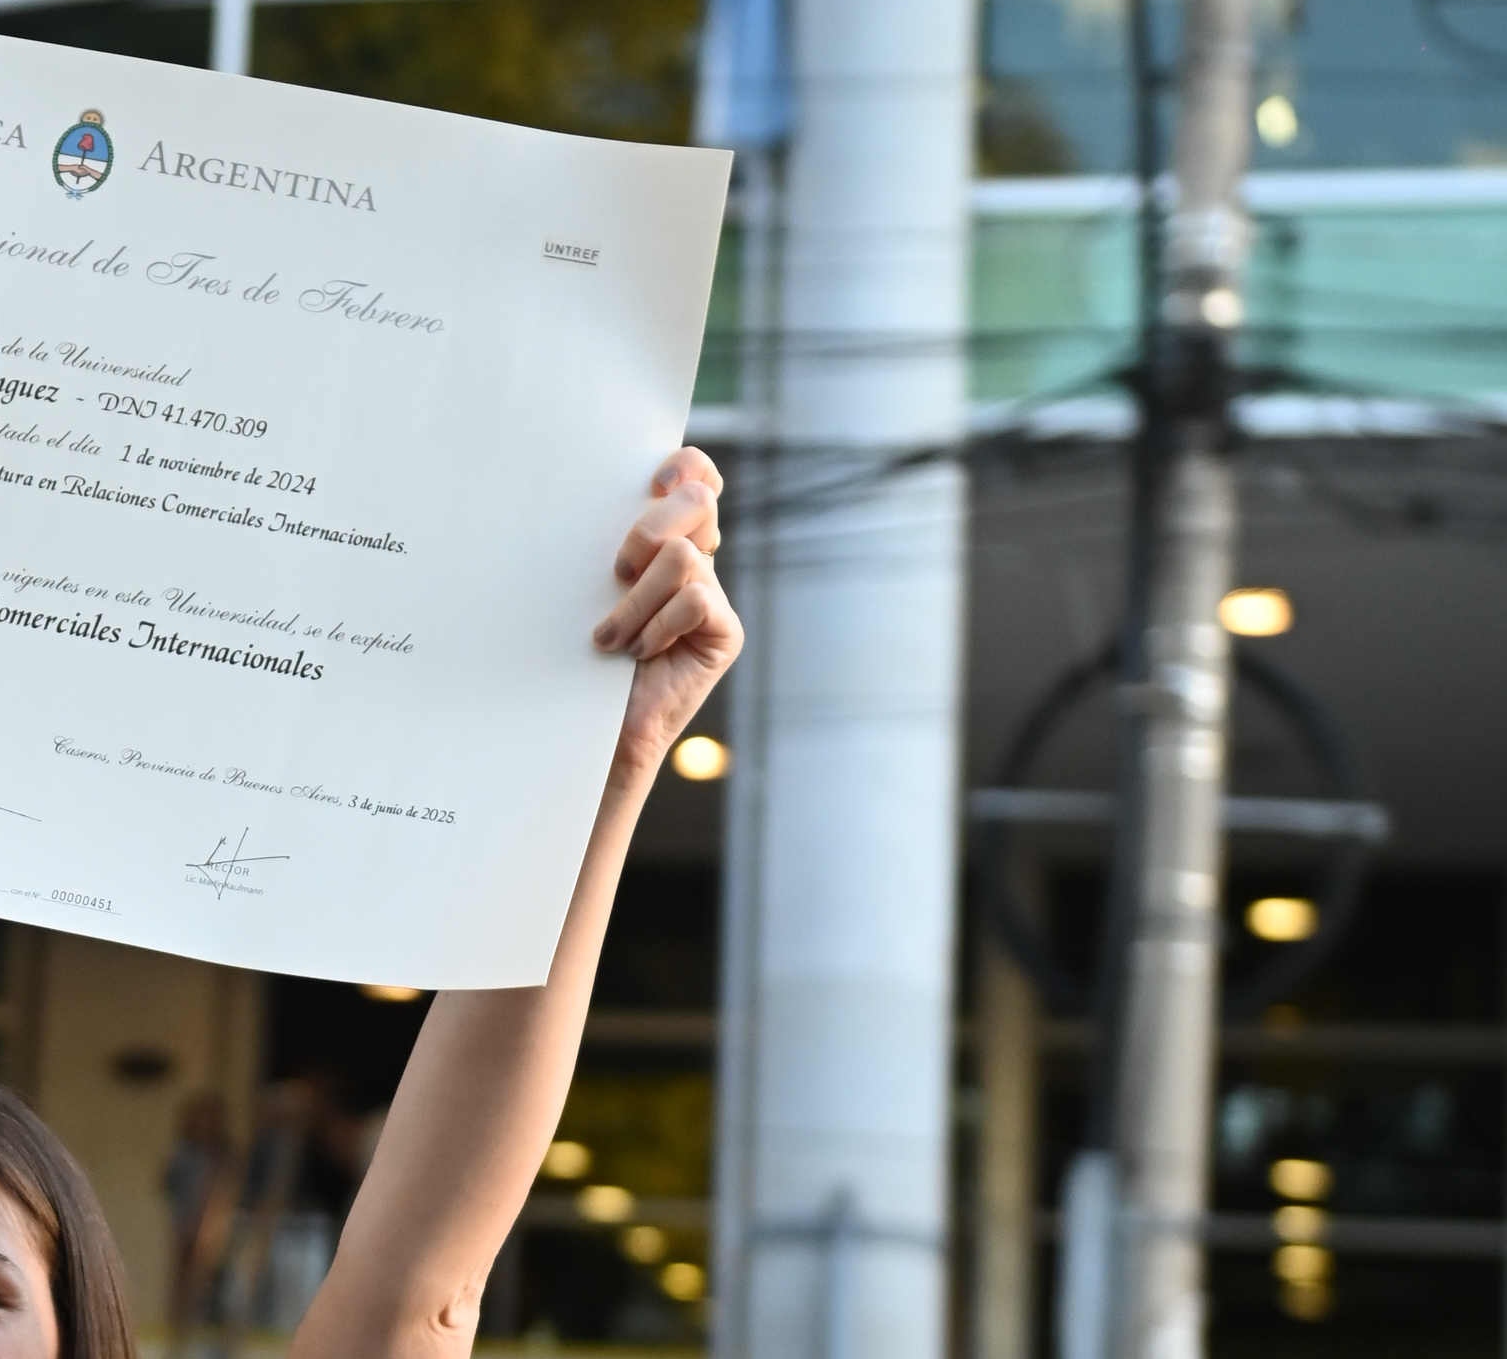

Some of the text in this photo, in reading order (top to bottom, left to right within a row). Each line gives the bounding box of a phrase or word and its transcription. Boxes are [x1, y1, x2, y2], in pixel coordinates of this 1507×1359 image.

[545, 242, 600, 260] UNTREF
[93, 246, 129, 277] de
[146, 253, 231, 295] Tres
[243, 273, 280, 304] de
[299, 280, 443, 333] Febrero
[1, 337, 24, 356] de
[29, 341, 49, 361] la
[55, 342, 192, 386] Universidad
[98, 392, 158, 419] DNI
[161, 404, 267, 438] 41.470.309
[47, 430, 72, 448] el
[69, 434, 101, 455] día
[119, 444, 132, 462] 1
[136, 447, 155, 466] de
[158, 458, 241, 481] noviembre
[244, 467, 263, 485] de
[266, 470, 316, 495] 2024
[38, 478, 57, 491] en
[60, 475, 156, 509] Relaciones
[162, 493, 264, 528] Comerciales
[268, 512, 407, 554] Internacionales.
[1, 568, 79, 593] vigentes
[85, 587, 109, 599] en
[115, 590, 151, 606] esta
[161, 588, 300, 636] Universidad,
[303, 625, 322, 637] se
[327, 622, 345, 641] le
[351, 633, 413, 654] expide
[128, 620, 324, 680] Internacionales
[54, 735, 456, 824] Caseros, Provincia de Buenos Aires, 3 de junio de 2025.
[186, 875, 197, 883] Lic.
[224, 882, 263, 895] Kaufmann
[206, 861, 250, 876] RECTOR
[51, 889, 112, 911] 00000451
